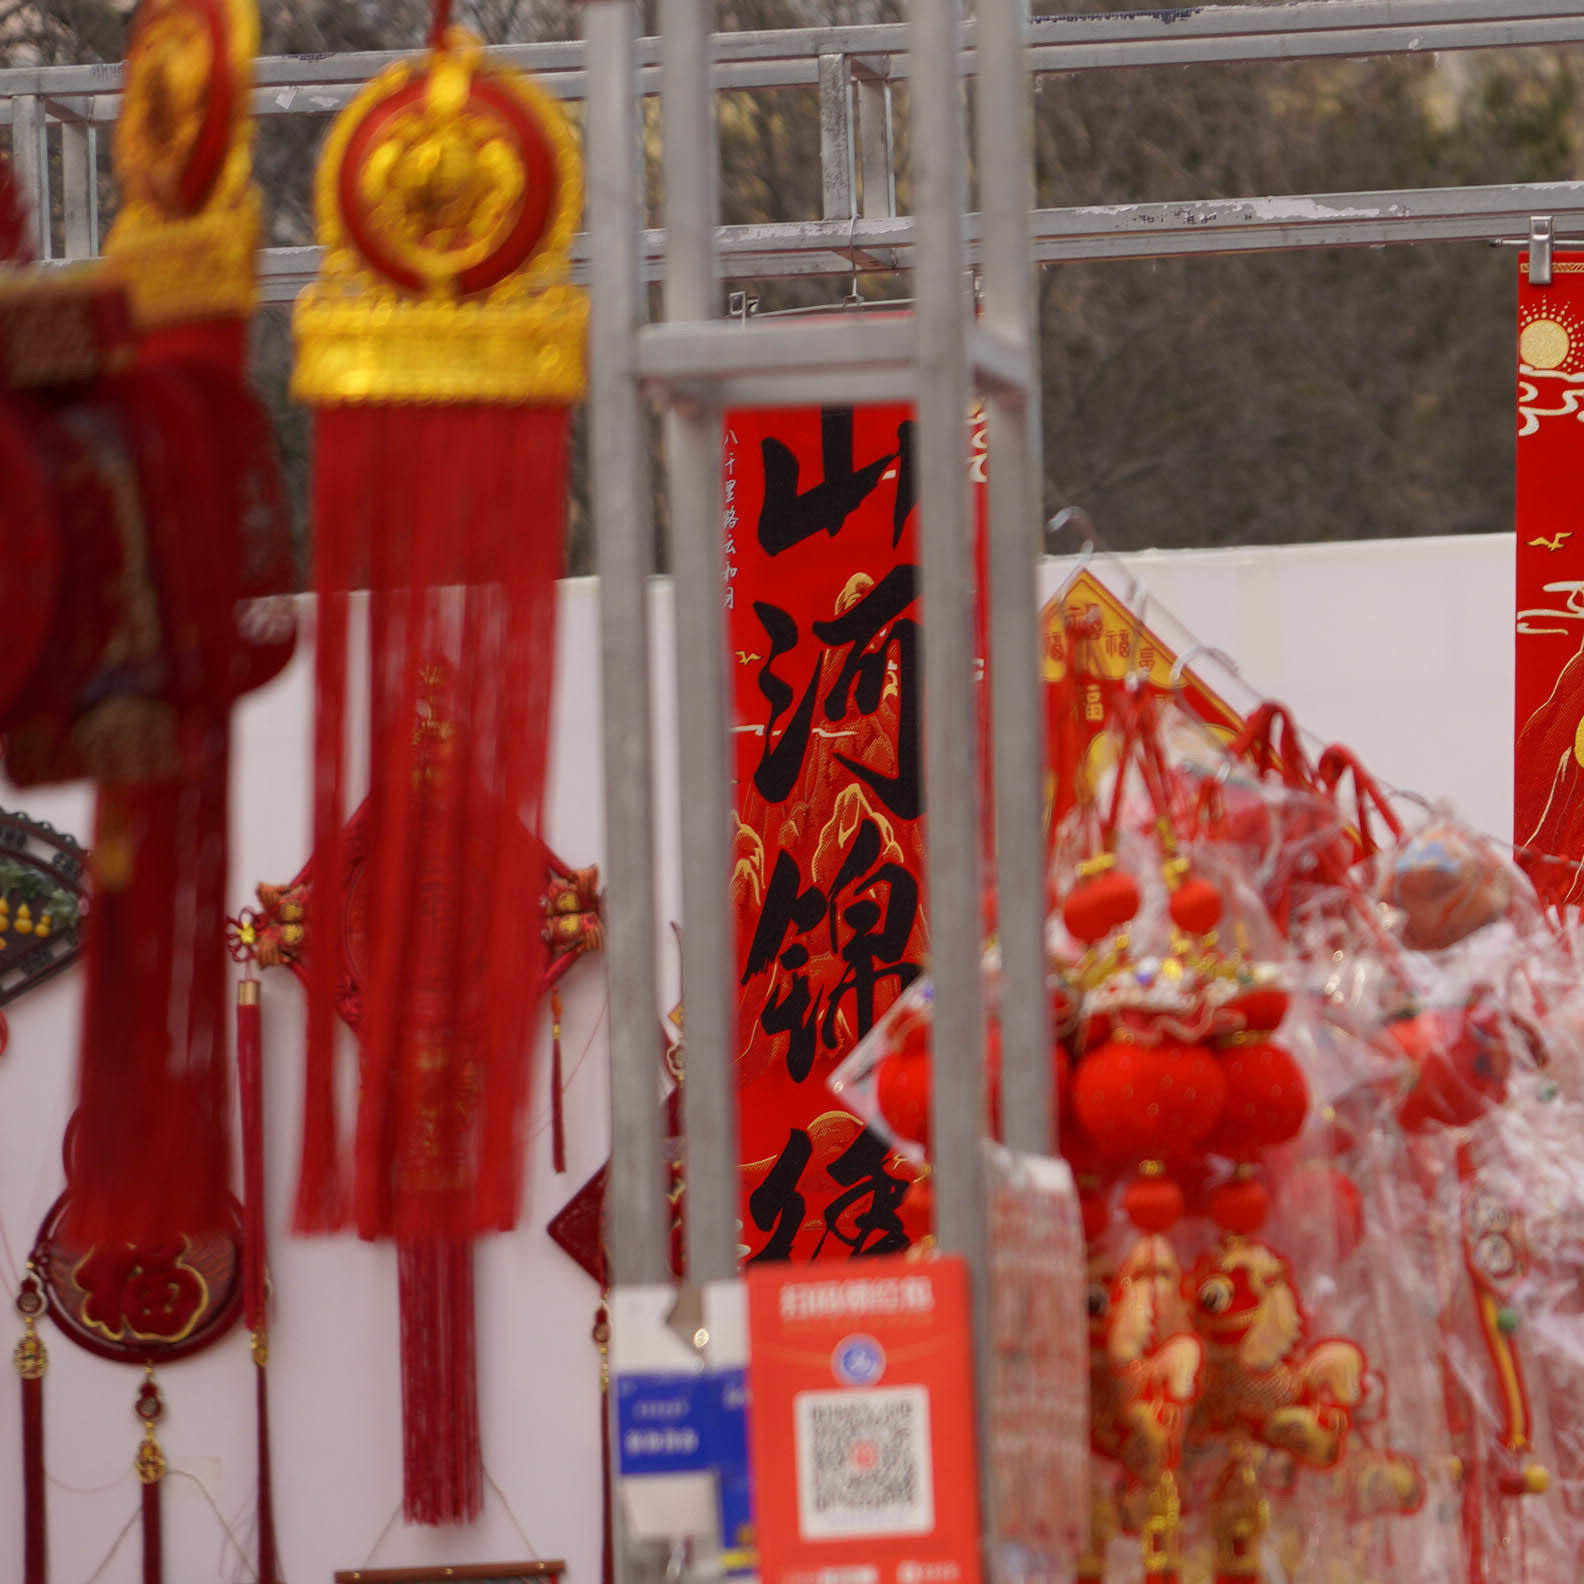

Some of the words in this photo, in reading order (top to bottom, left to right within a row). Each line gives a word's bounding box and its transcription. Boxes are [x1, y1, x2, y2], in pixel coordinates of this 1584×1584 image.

[722, 430, 740, 609] 八千里路云和月
